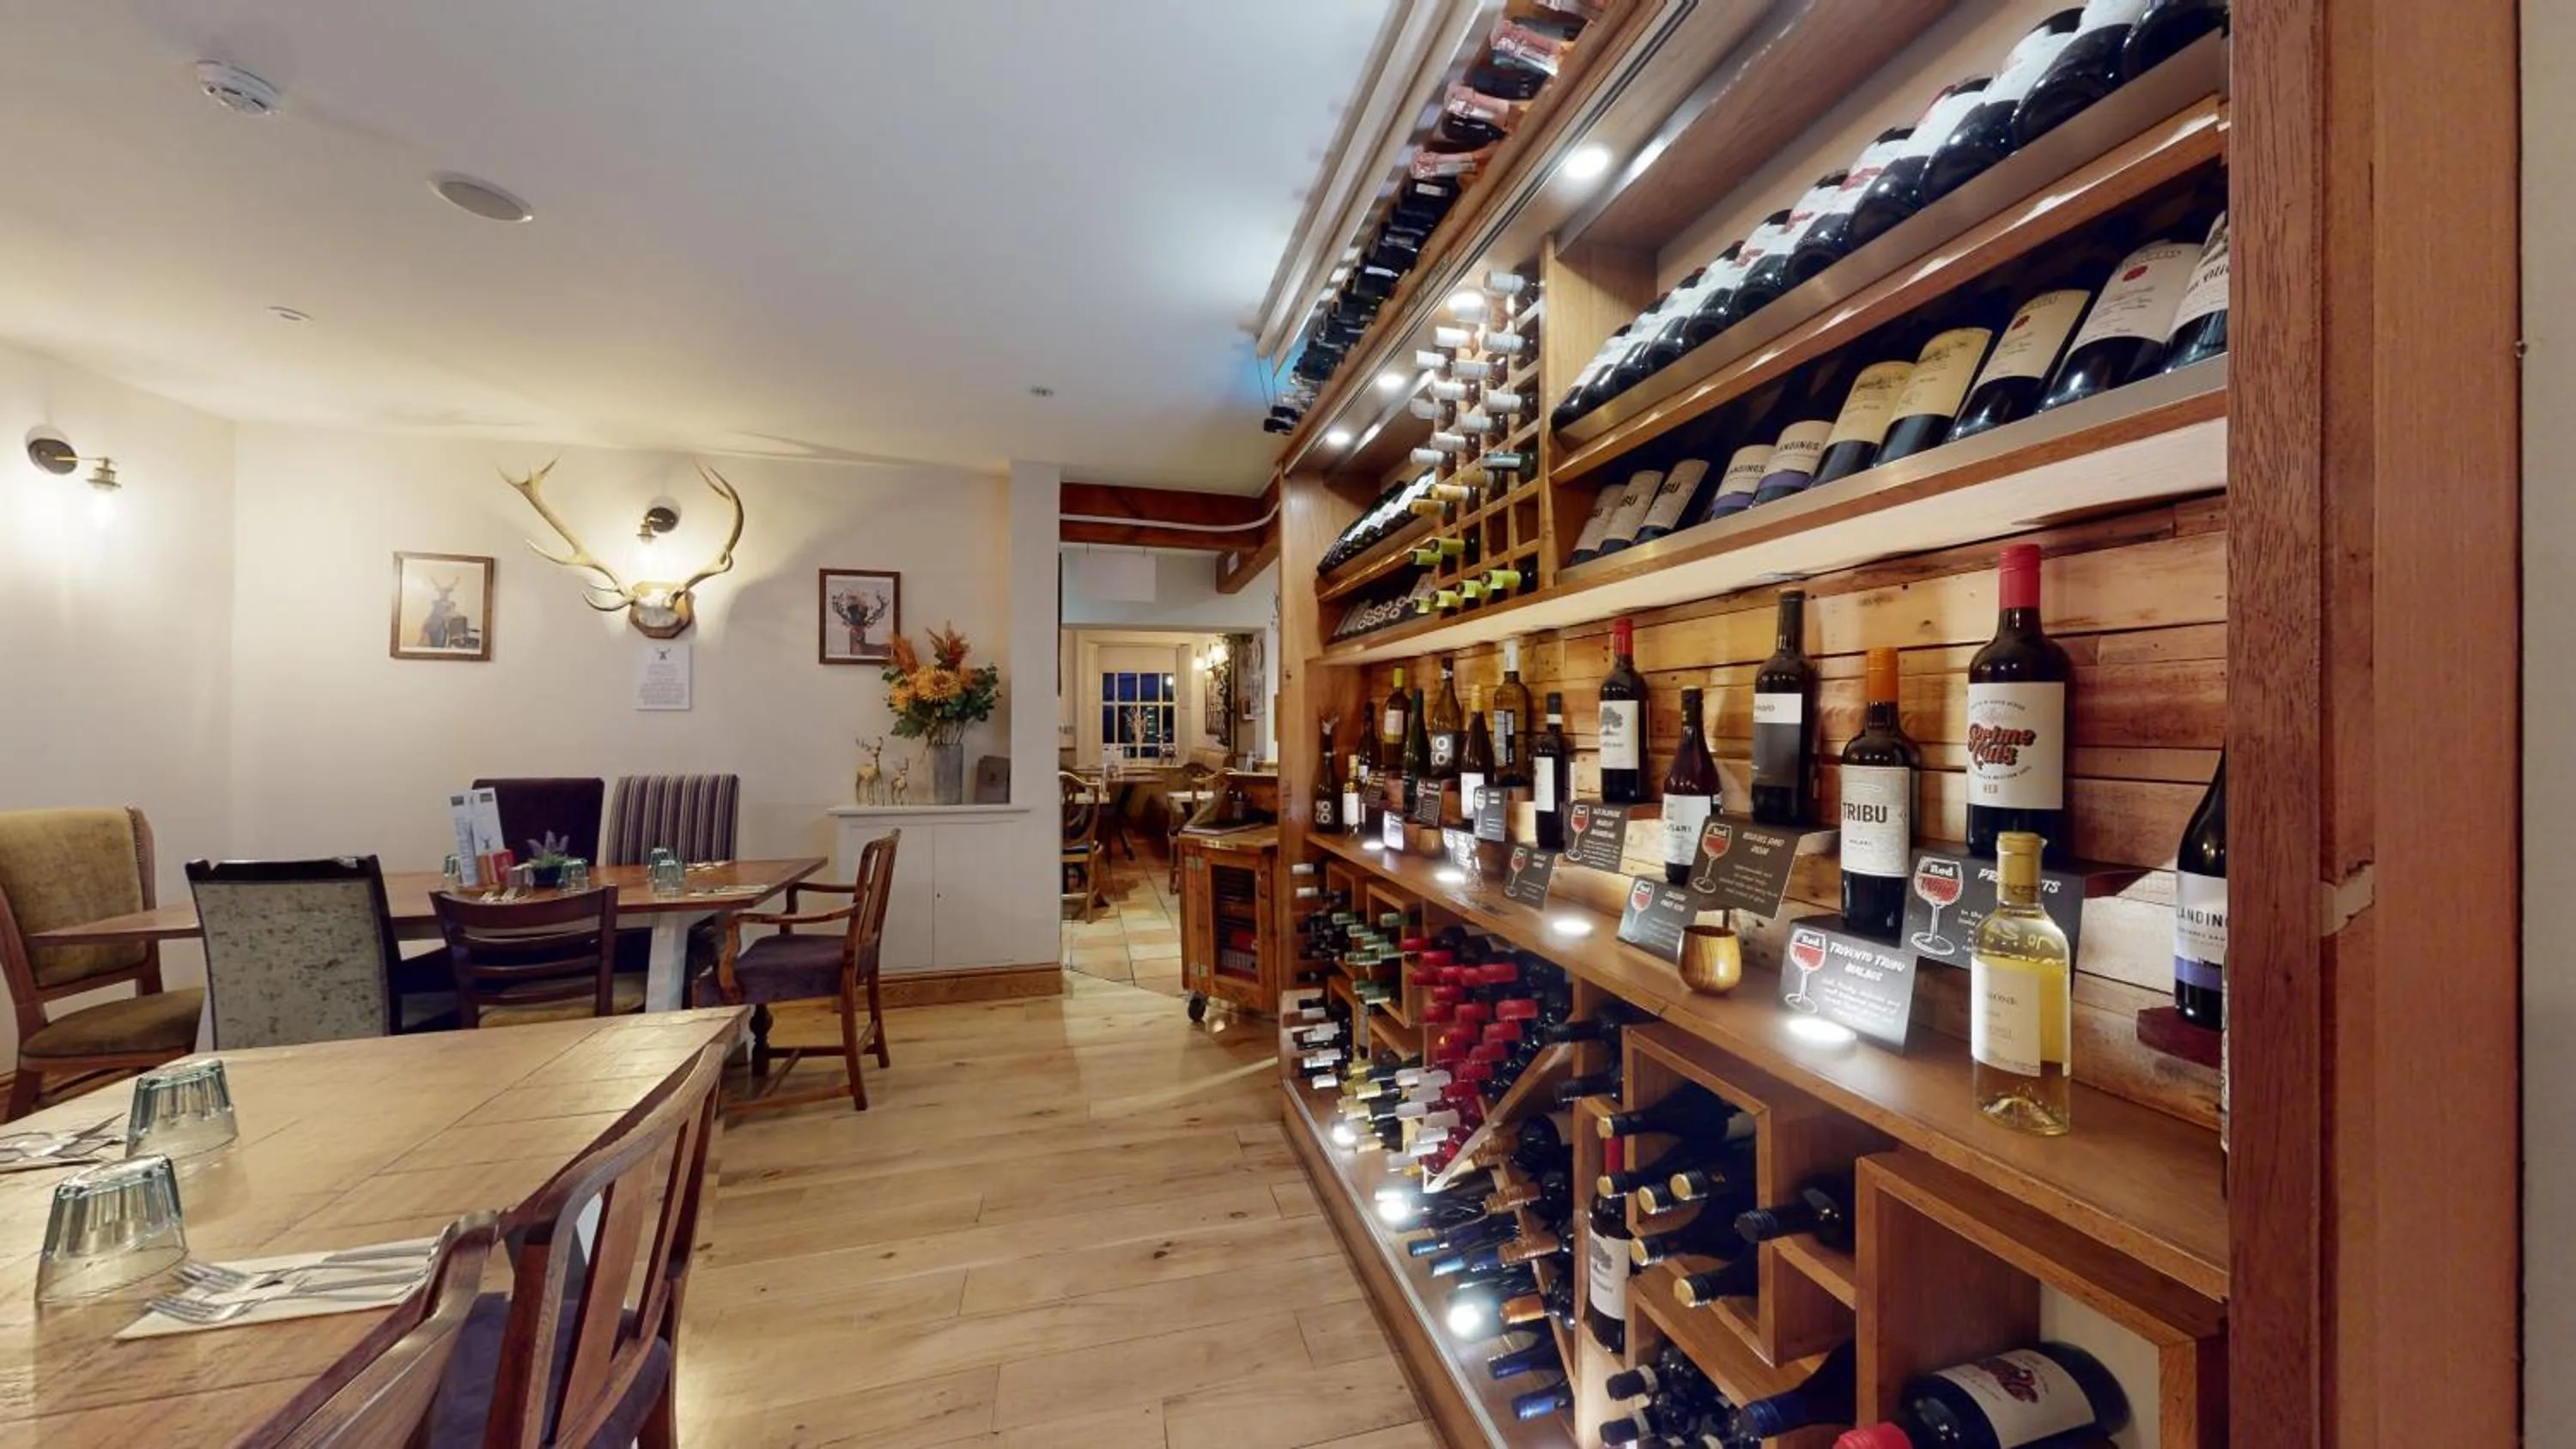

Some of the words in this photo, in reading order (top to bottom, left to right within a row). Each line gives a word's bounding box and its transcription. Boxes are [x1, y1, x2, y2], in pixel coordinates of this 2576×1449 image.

[1842, 802, 1888, 824] TRIBU
[1930, 863, 1953, 876] Red
[2176, 906, 2228, 927] LANDIN
